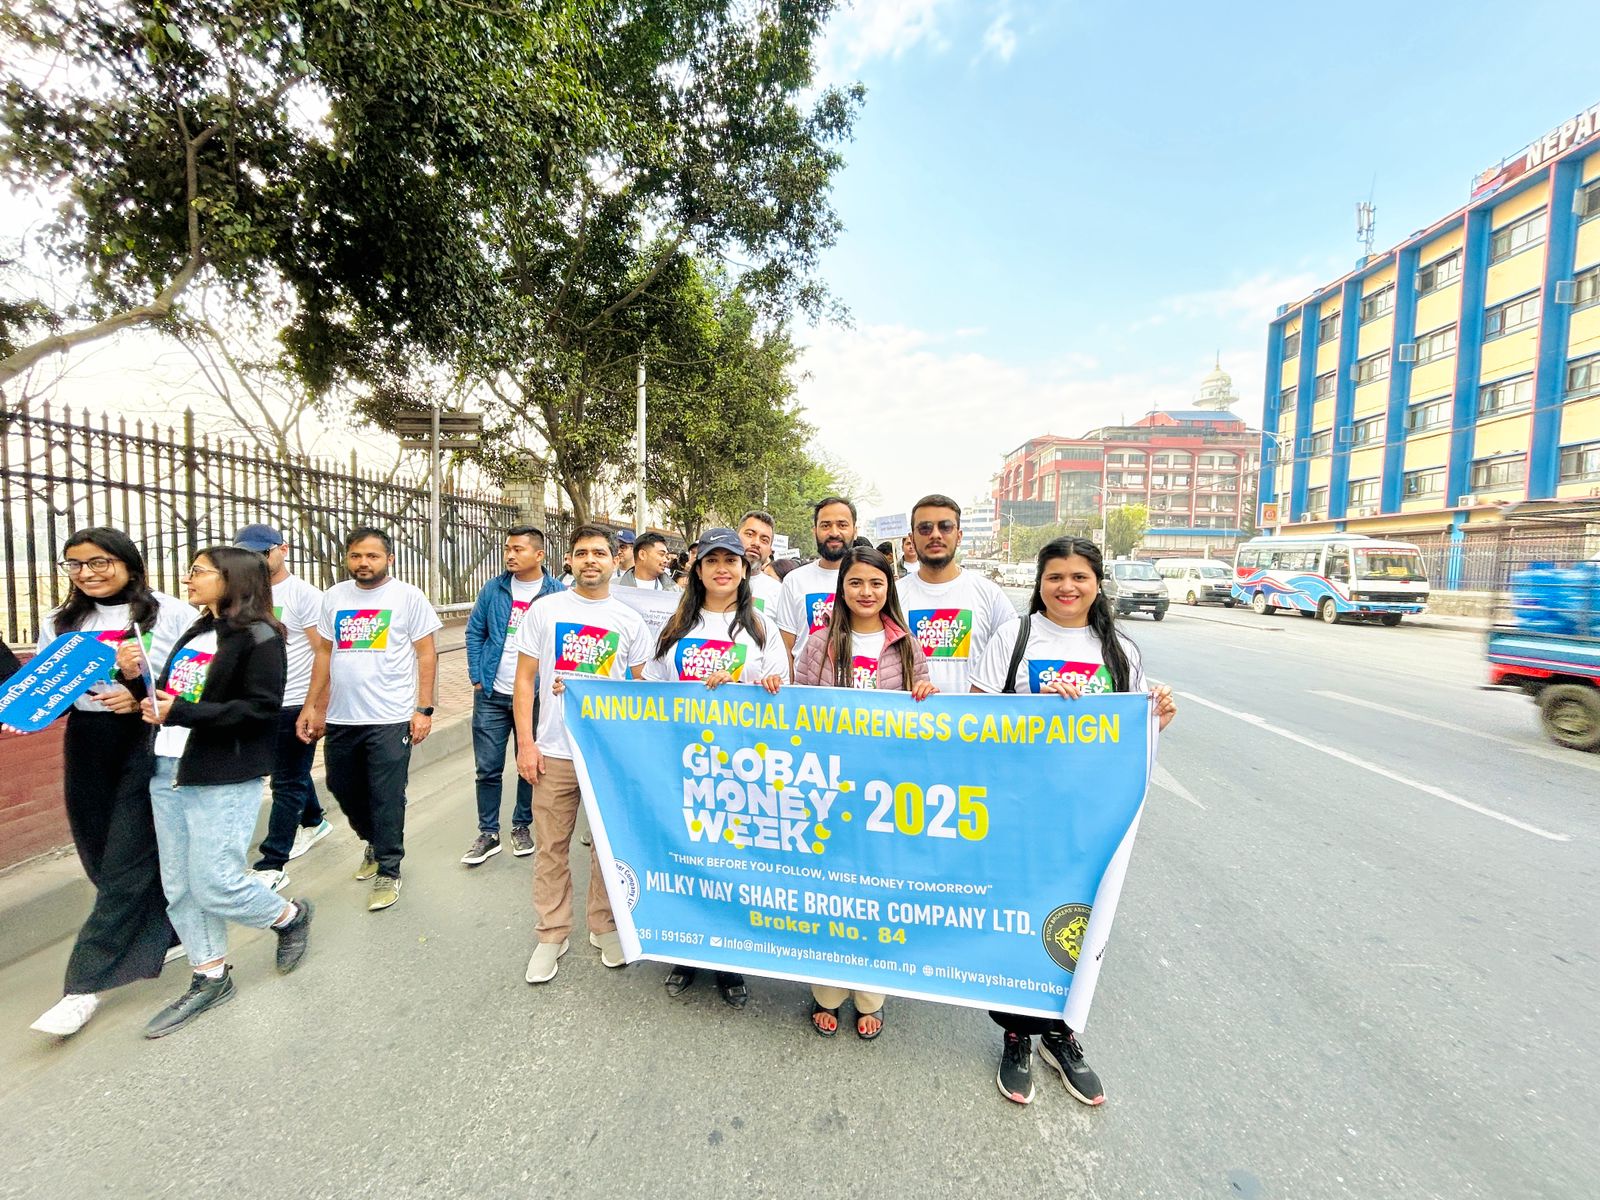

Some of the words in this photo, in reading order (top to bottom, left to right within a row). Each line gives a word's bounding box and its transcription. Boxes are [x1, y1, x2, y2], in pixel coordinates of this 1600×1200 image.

[917, 619, 966, 630] GLOBAL
[562, 633, 612, 651] GLOBAL
[917, 629, 961, 638] MONEY
[562, 642, 607, 656] MONEY
[683, 647, 739, 662] GLOBAL
[562, 651, 597, 665] WEEK
[682, 655, 734, 670] MONEY
[683, 666, 716, 678] WEE
[1039, 670, 1109, 687] GLOBAL
[581, 695, 670, 721] ANNUAL
[674, 698, 790, 730] FINANCIAL
[795, 704, 951, 741] AWARENESS
[958, 714, 1120, 744] CAMPAIGN
[682, 742, 856, 791] GLOBAL
[683, 776, 838, 822] MONEY
[864, 780, 989, 841] 2025
[682, 808, 813, 854] WEEK
[706, 857, 748, 870] BEFORE
[750, 861, 773, 873] YOU
[775, 864, 825, 881] FOLLOW,
[828, 870, 858, 885] WISE
[859, 874, 905, 889] MONEY
[646, 870, 695, 896] MILKY
[698, 878, 734, 903] WAY
[739, 883, 799, 912] SHARE
[804, 891, 881, 922] BROKER
[887, 901, 986, 930] COMPANY
[992, 909, 1036, 936] LTD.
[750, 910, 821, 934] Broker
[829, 923, 868, 941] No.
[878, 927, 906, 945] 84
[661, 930, 705, 945] 5915637
